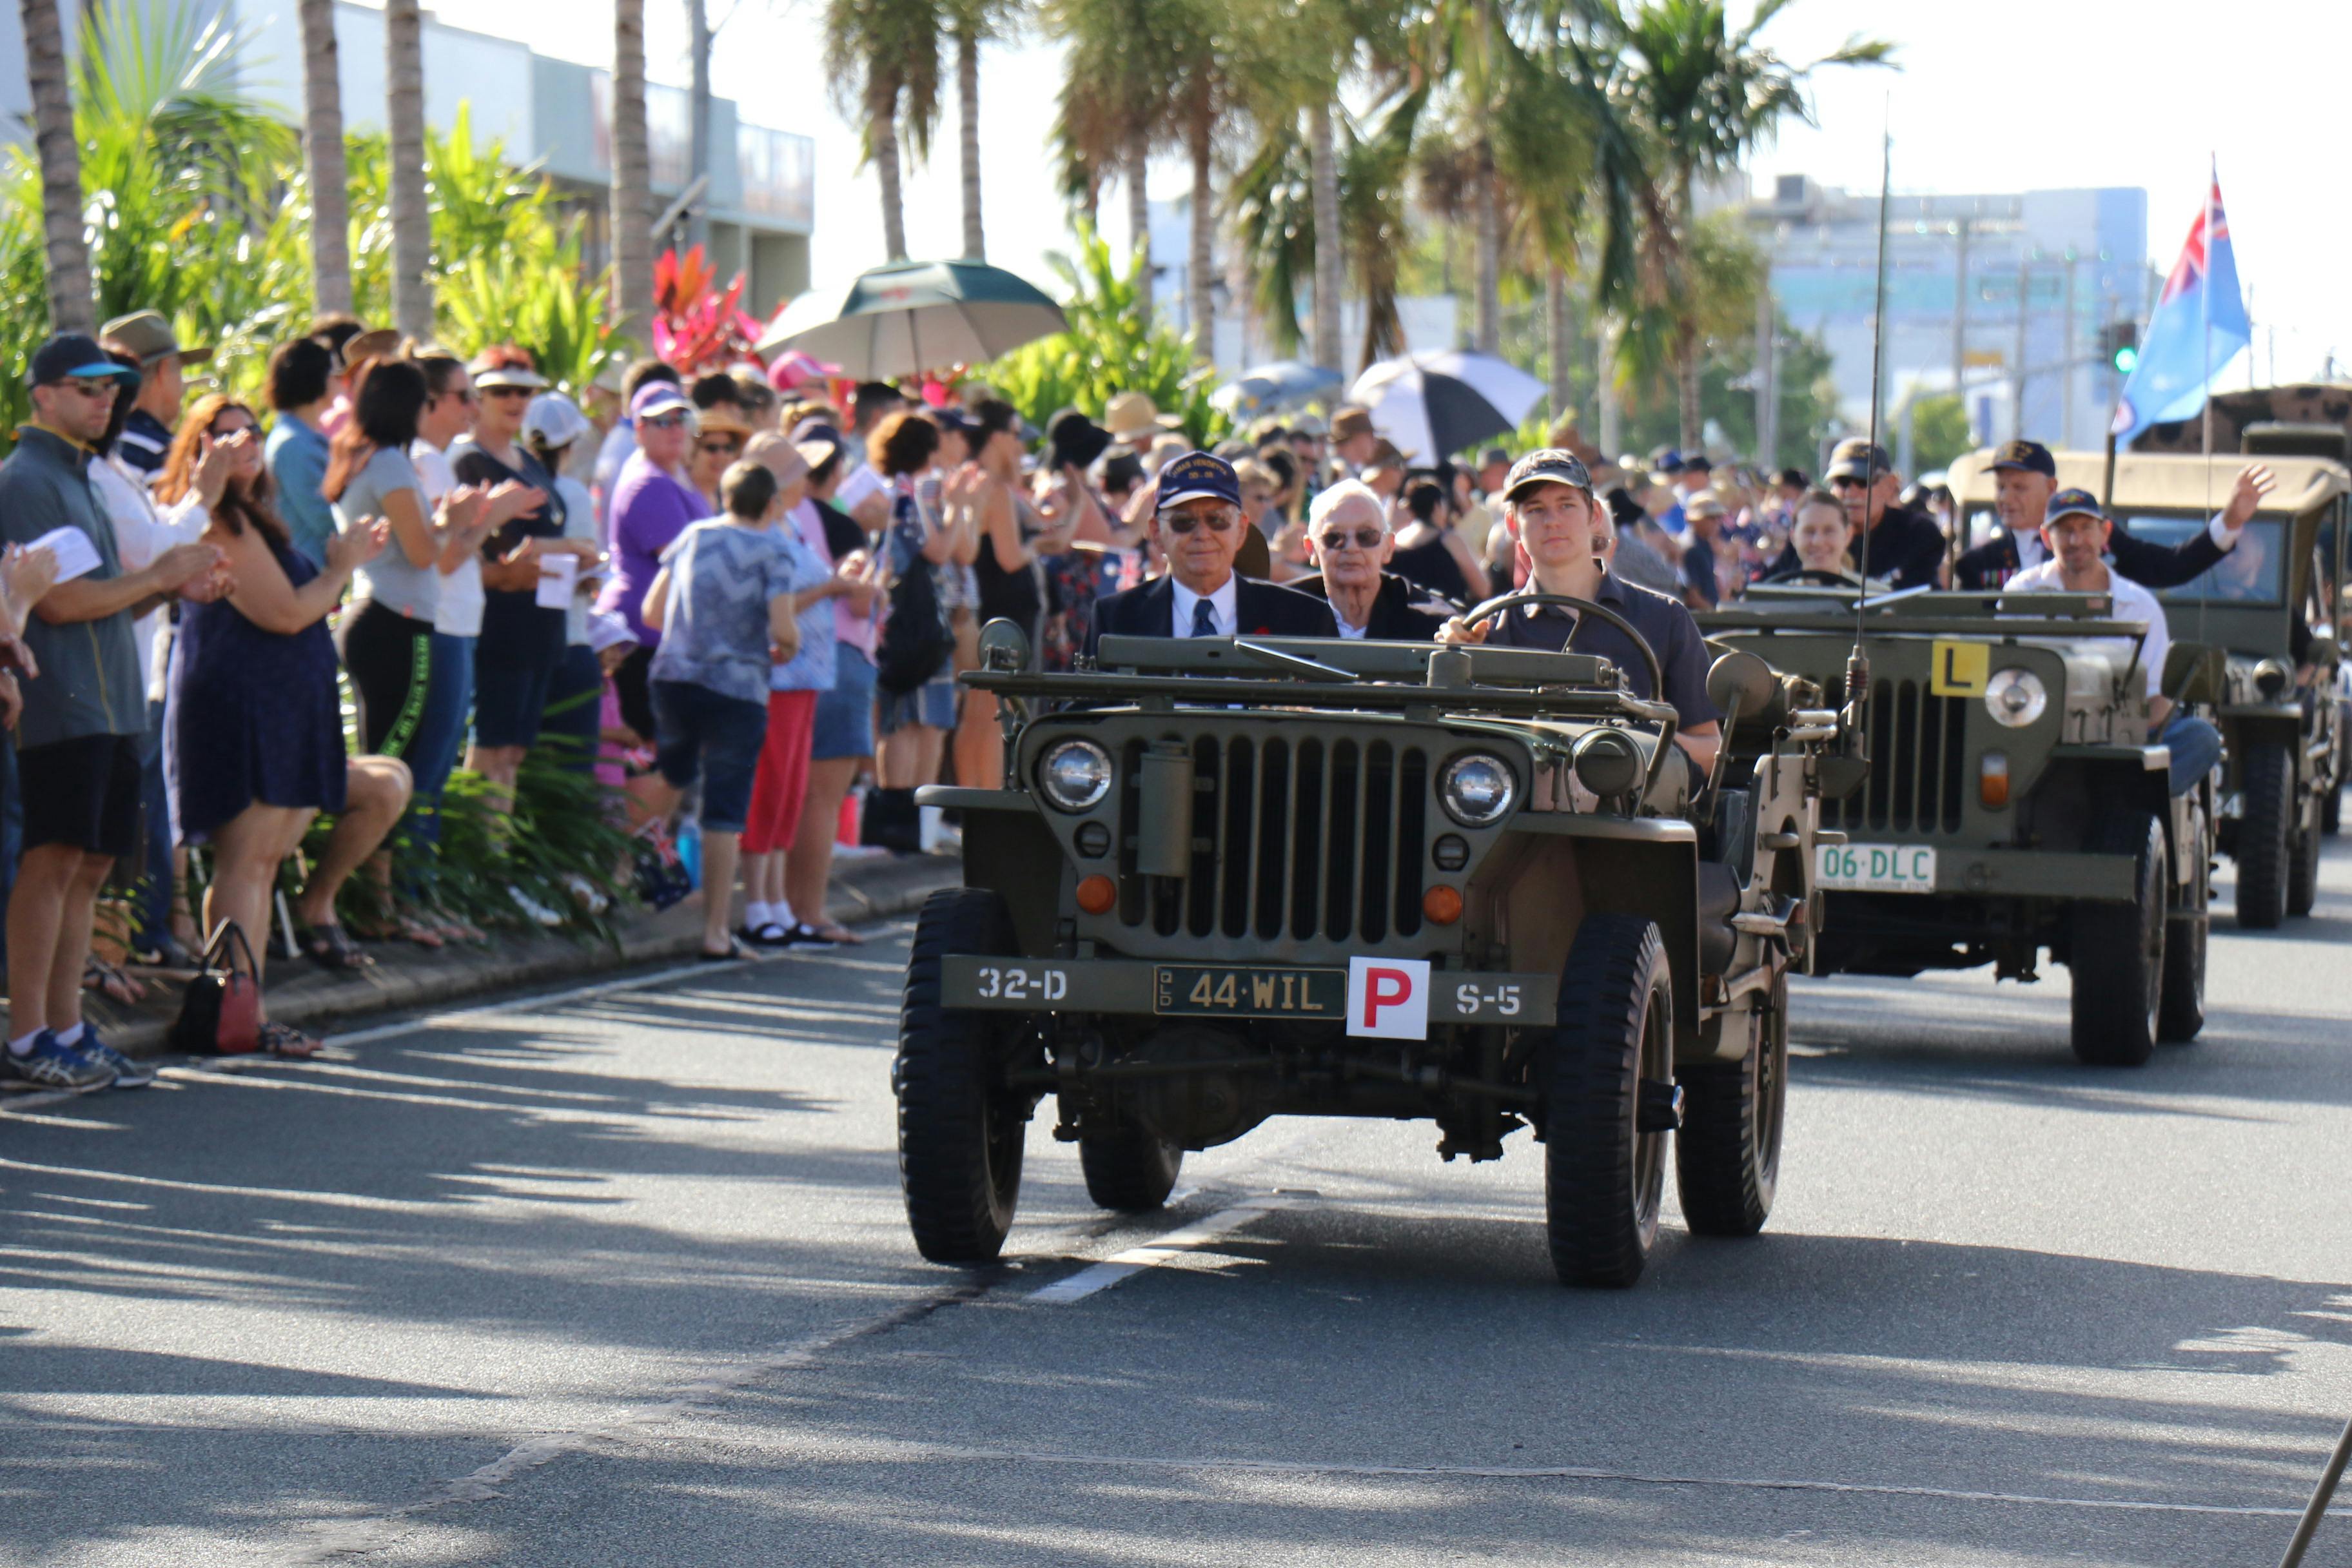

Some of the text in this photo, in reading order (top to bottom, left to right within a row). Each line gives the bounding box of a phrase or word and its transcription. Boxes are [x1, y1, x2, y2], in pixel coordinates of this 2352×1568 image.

[1945, 648, 1972, 688] L
[978, 968, 1067, 1000] 32-D
[1364, 967, 1412, 1028] P
[1456, 984, 1520, 1015] S-5
